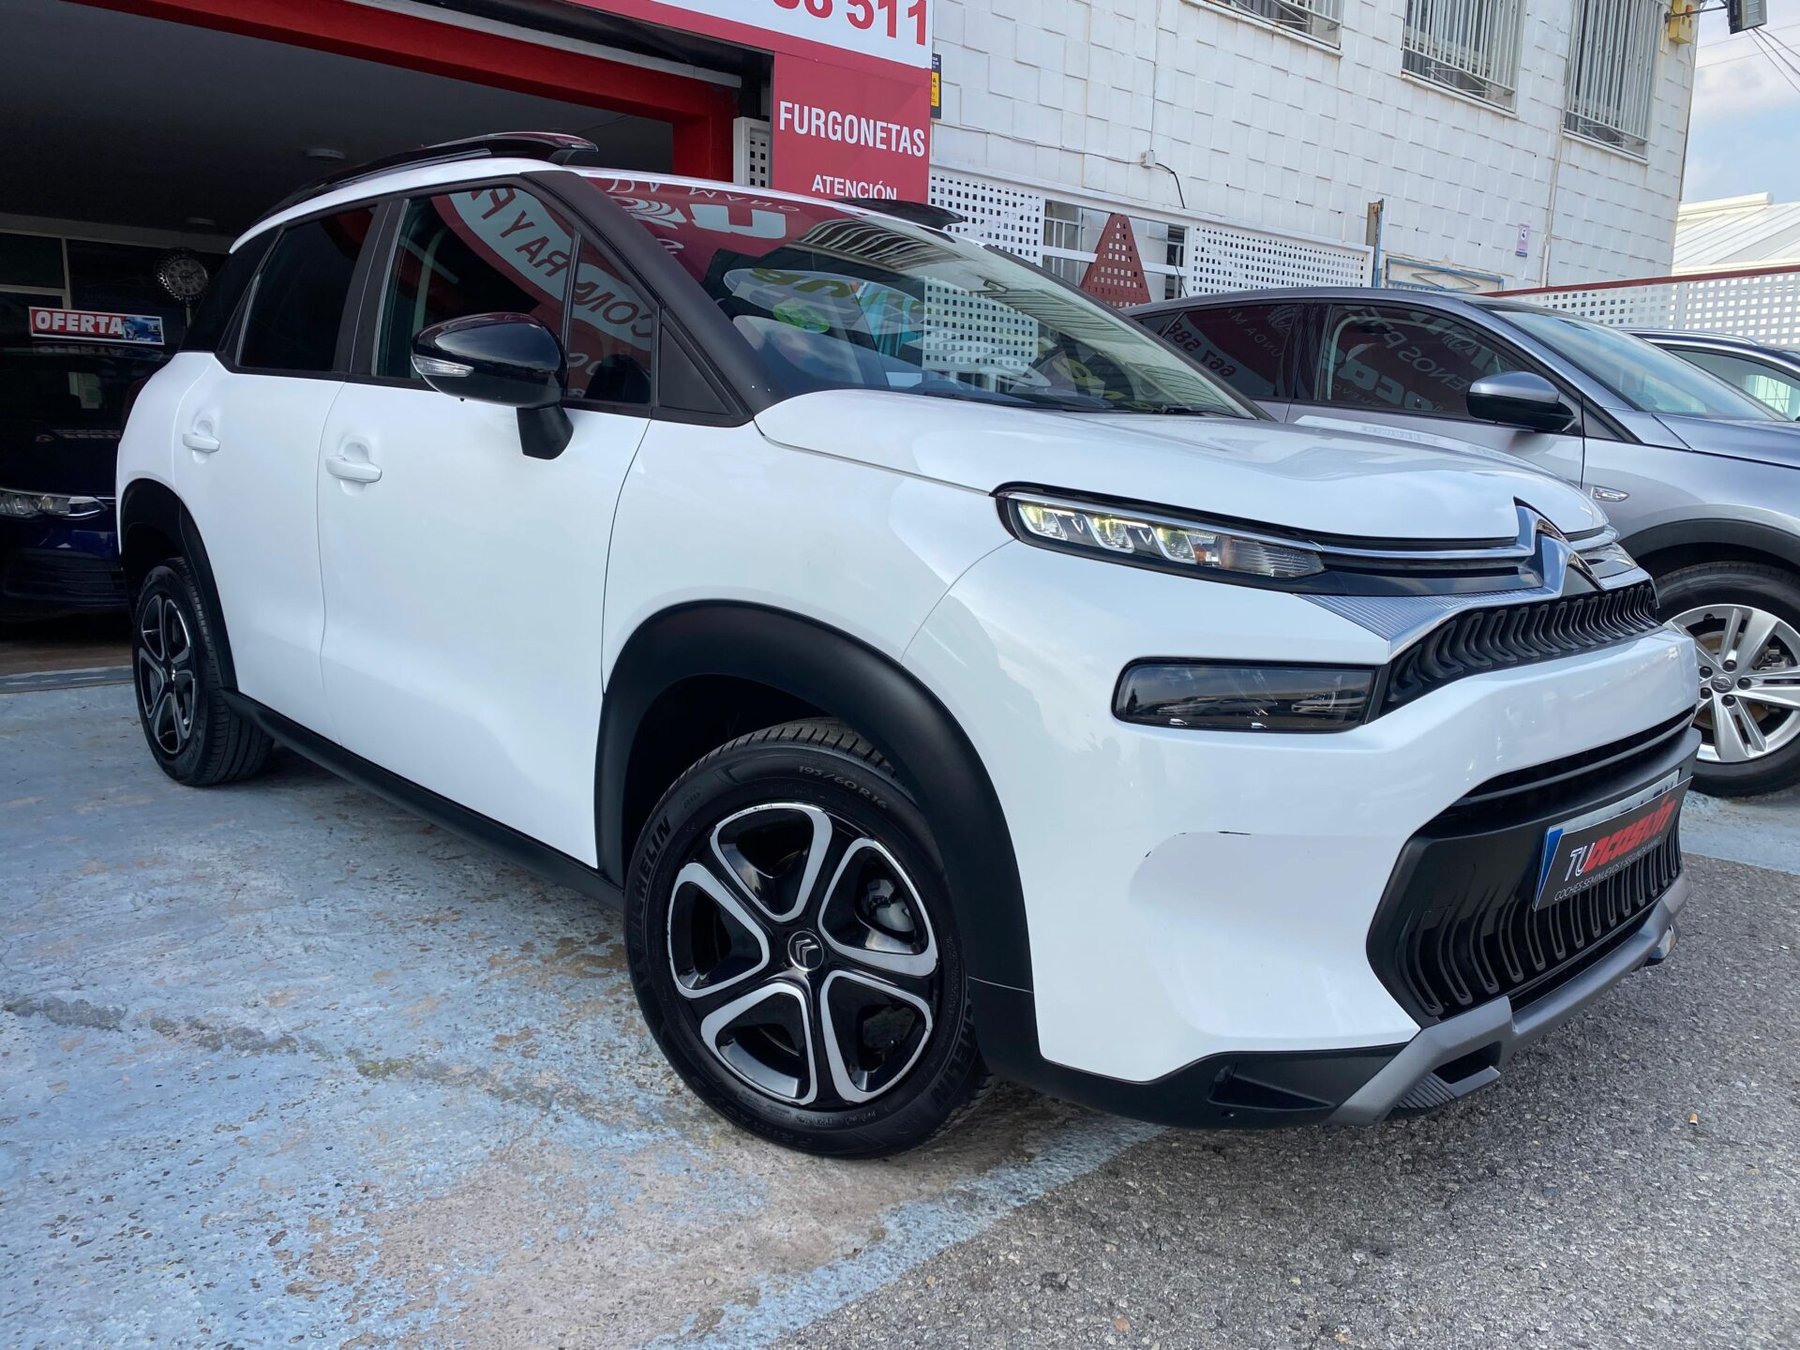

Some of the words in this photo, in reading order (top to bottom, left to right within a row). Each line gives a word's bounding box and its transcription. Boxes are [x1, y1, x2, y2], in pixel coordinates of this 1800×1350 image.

[847, 0, 927, 46] 511
[779, 100, 926, 158] FURGONETAS
[812, 173, 897, 201] ATENCIÓN
[35, 311, 124, 335] OFERTA
